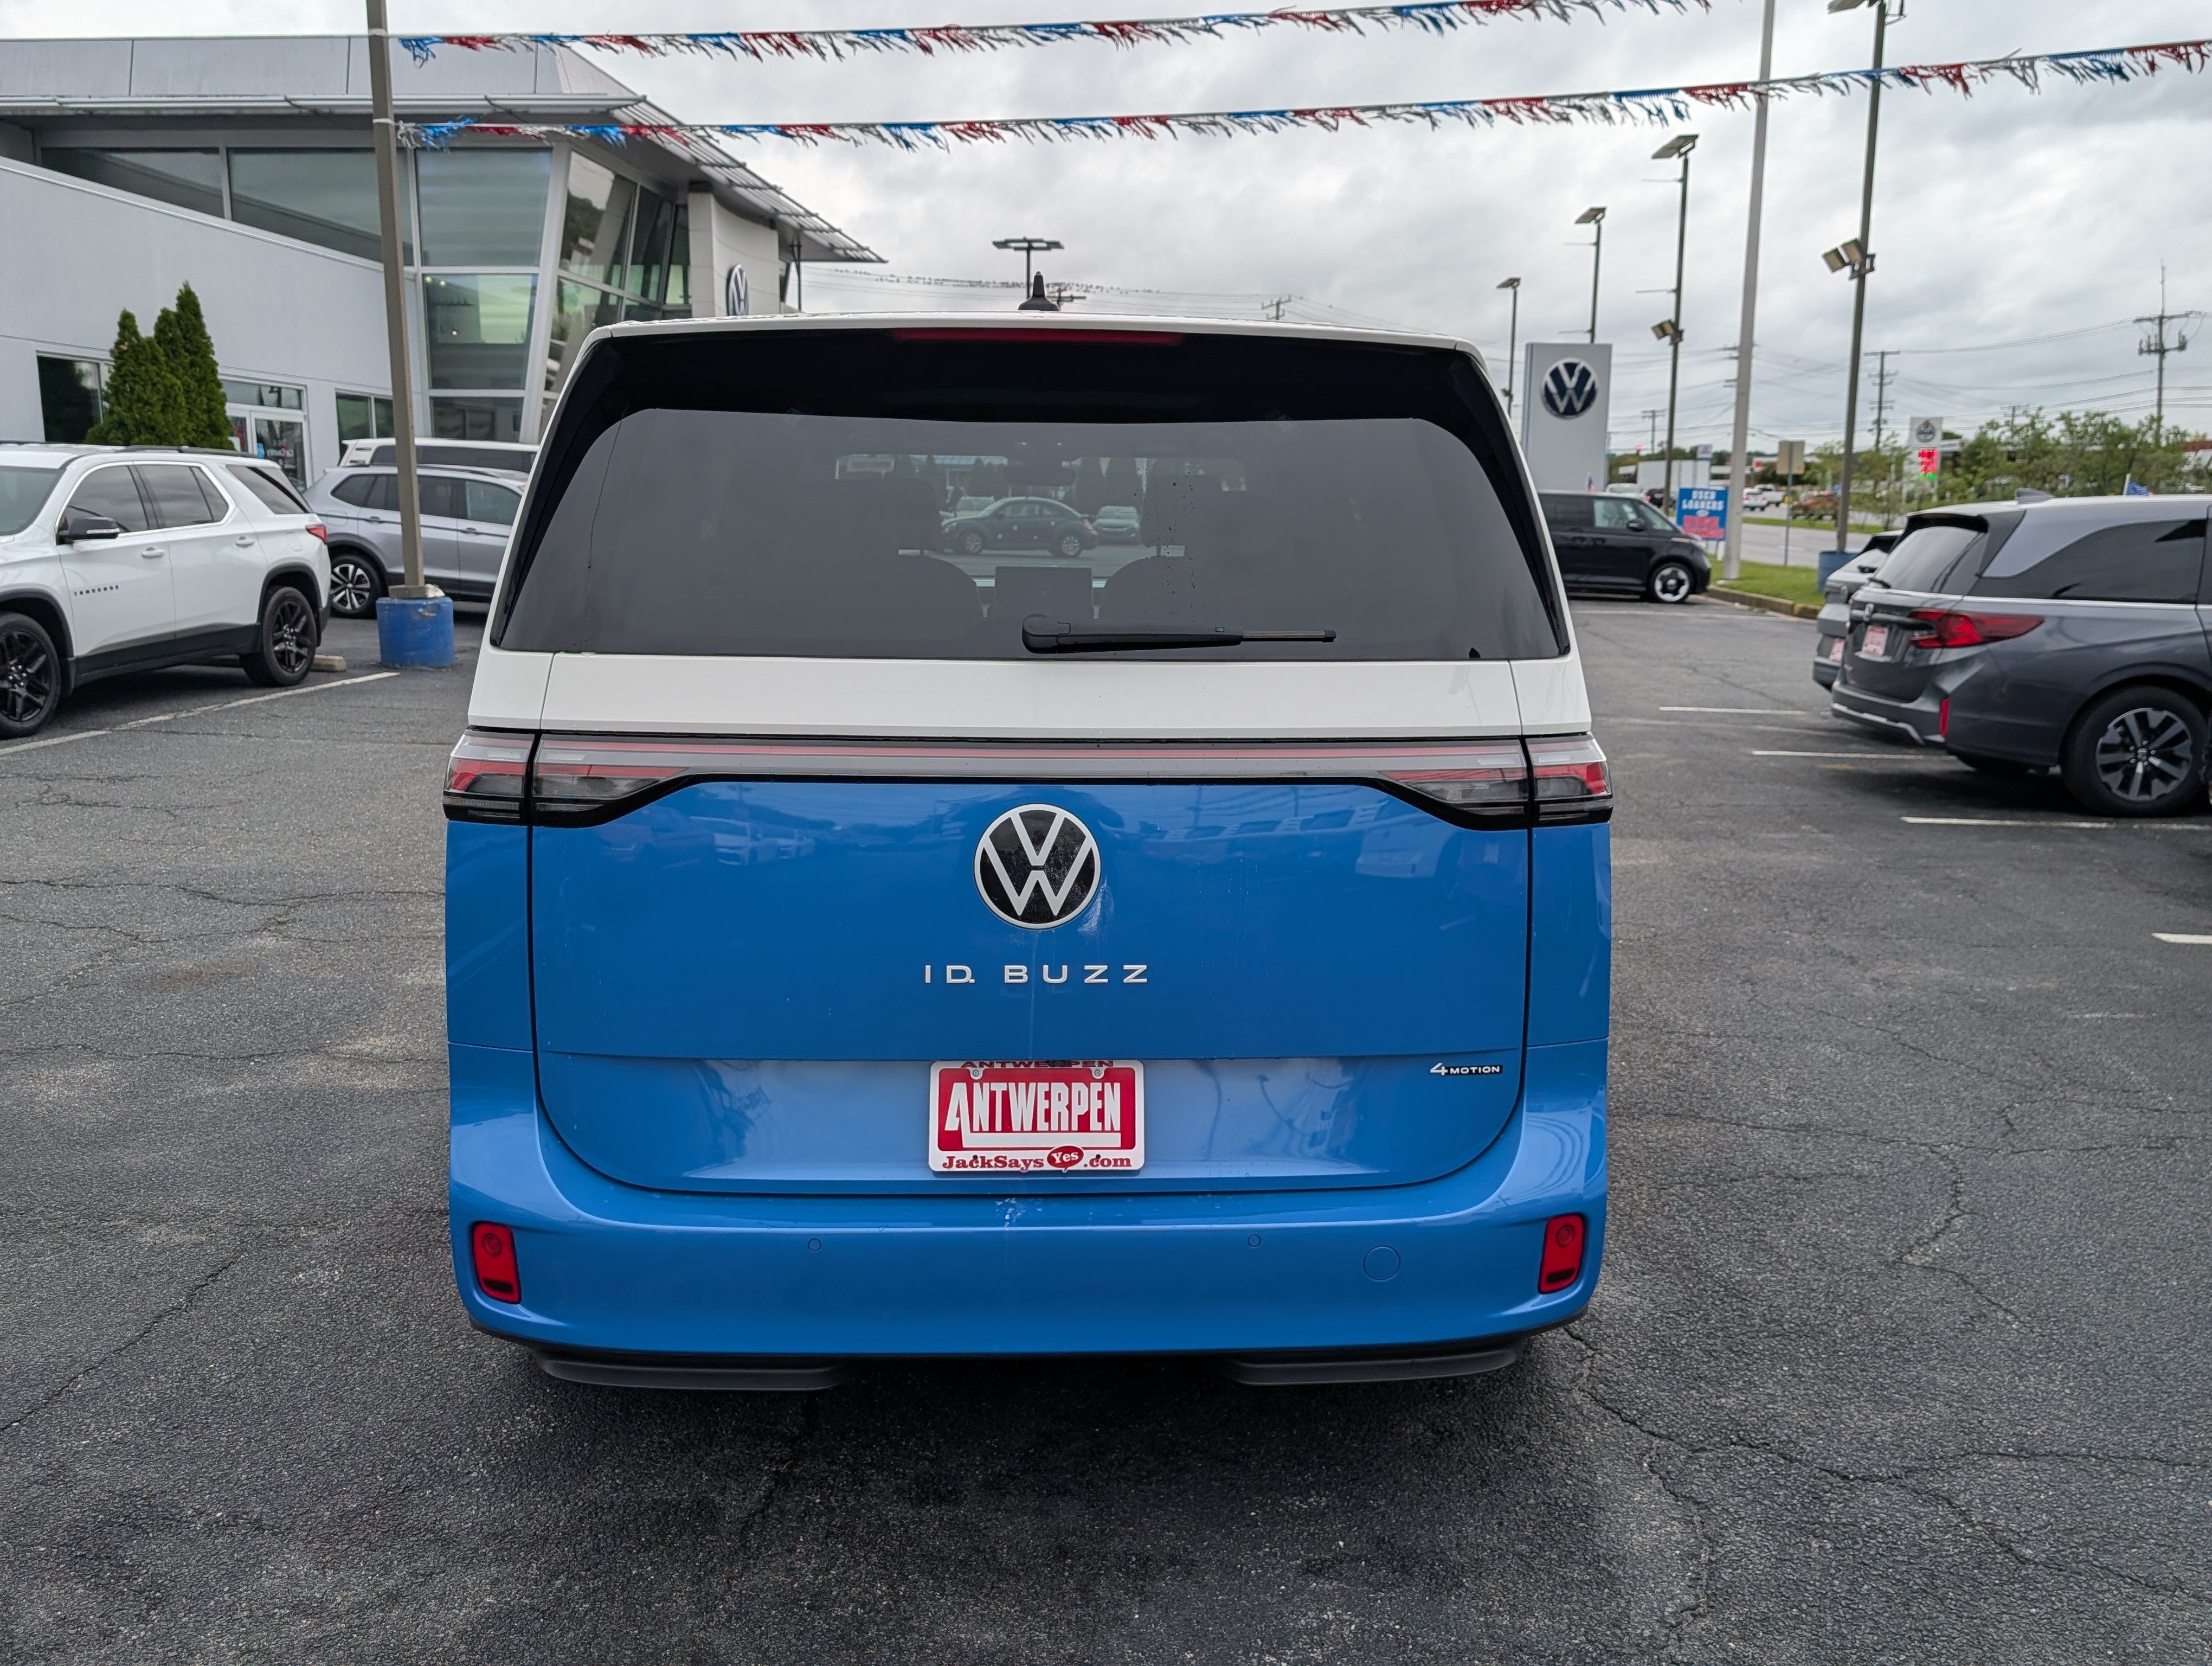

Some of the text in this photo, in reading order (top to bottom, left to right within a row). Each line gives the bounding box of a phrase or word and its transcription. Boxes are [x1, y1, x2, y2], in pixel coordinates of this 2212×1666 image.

[1541, 358, 1598, 419] VW
[974, 803, 1101, 930] VW
[1004, 965, 1147, 983] BUZZ
[1430, 1062, 1500, 1076] 4MOTION
[944, 1082, 1121, 1148] ANTWERPEN
[1051, 1150, 1079, 1164] Yes
